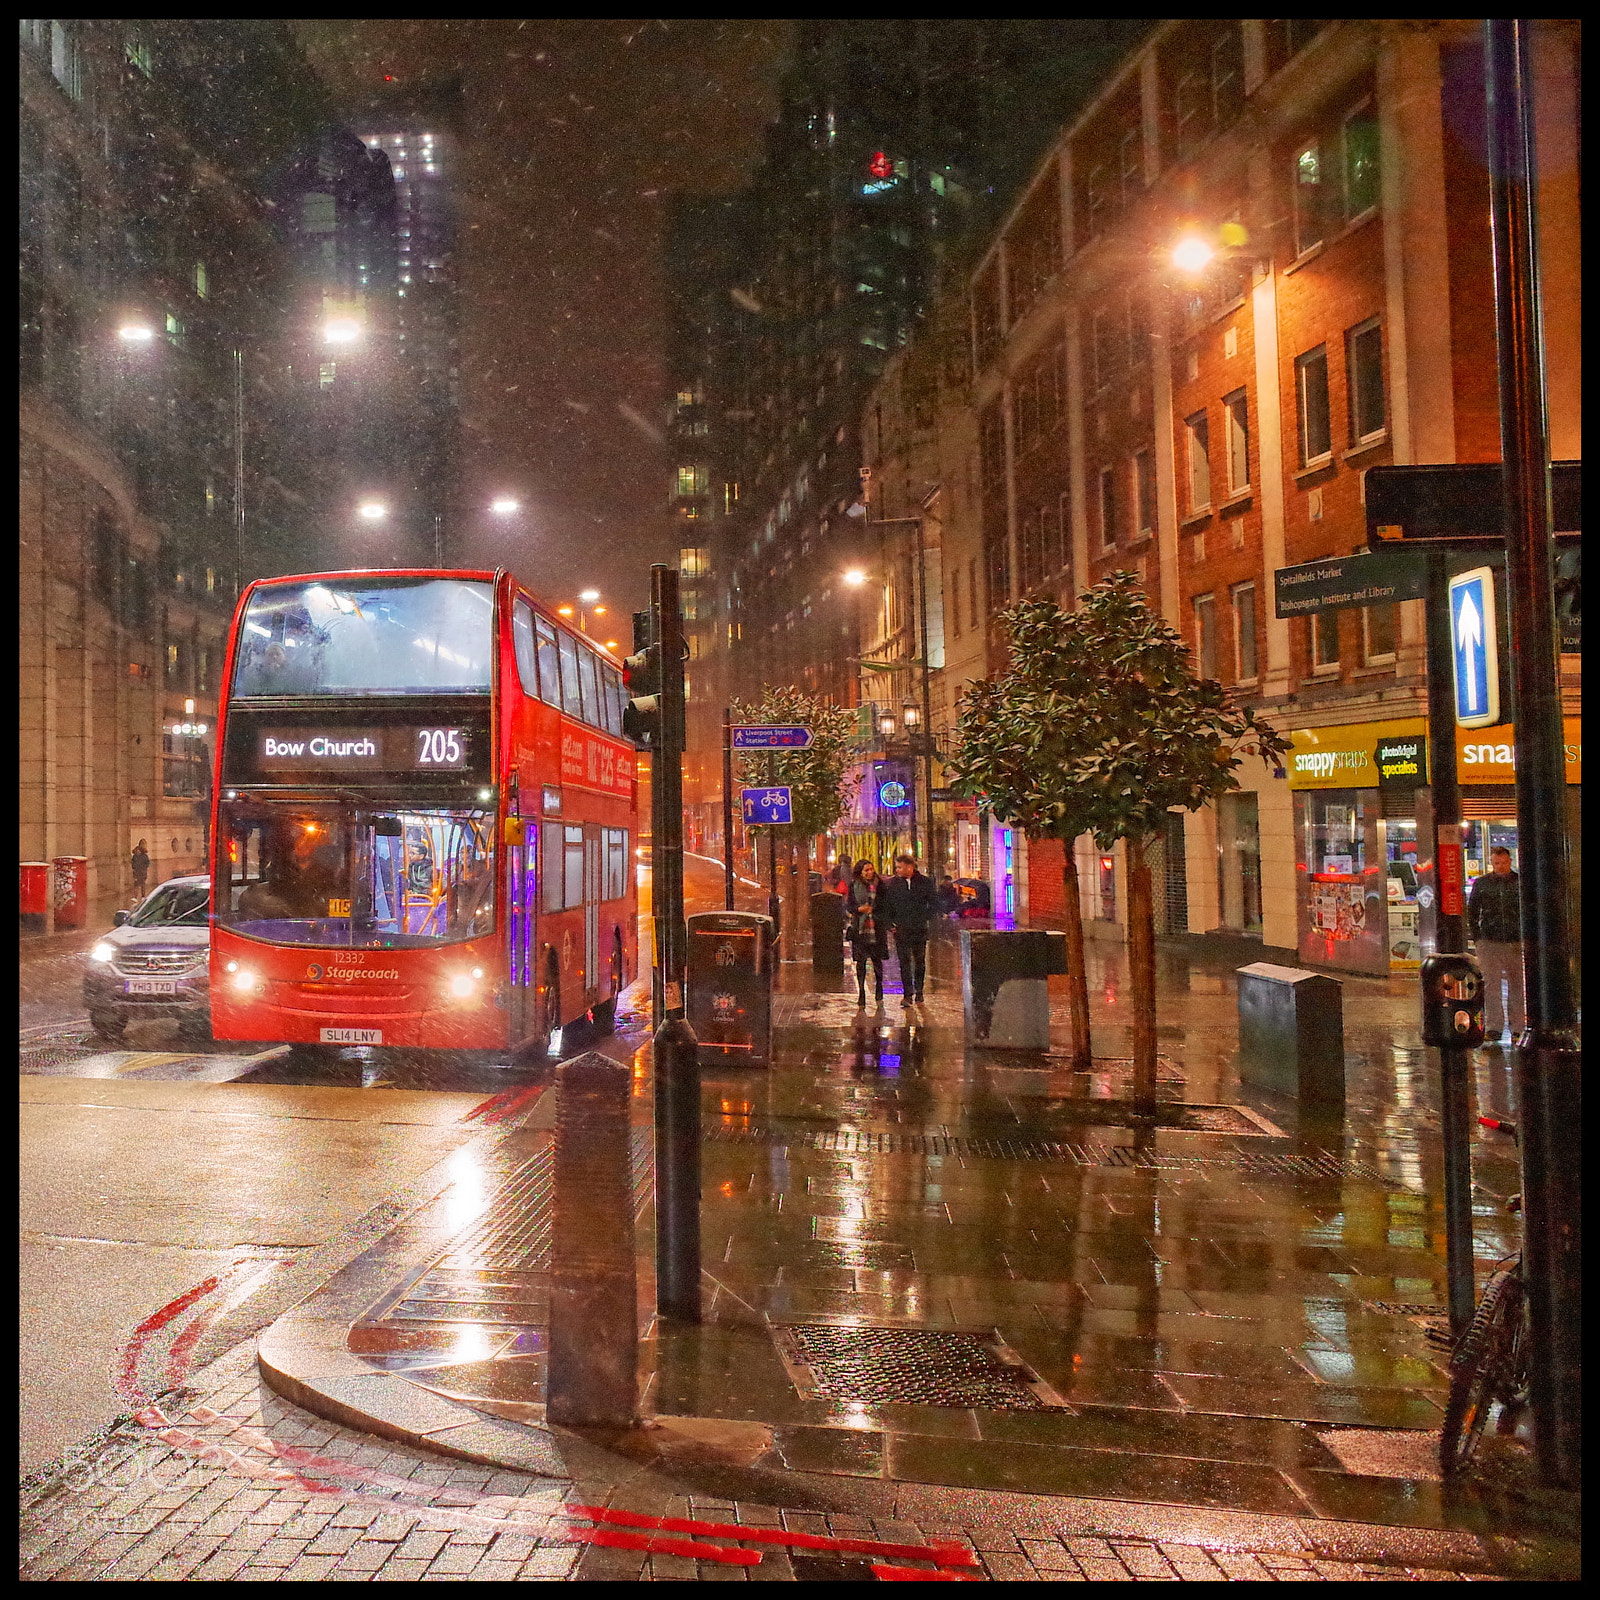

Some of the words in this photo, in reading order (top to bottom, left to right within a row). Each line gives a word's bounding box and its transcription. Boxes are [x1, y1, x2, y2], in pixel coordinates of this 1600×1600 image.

[1280, 573, 1316, 586] Spitalfields
[1317, 568, 1342, 580] Market
[1280, 598, 1319, 610] Bishopsgate
[1322, 592, 1350, 604] Institute
[1352, 589, 1366, 599] and
[1368, 586, 1395, 598] Library
[265, 738, 305, 756] Bow
[309, 737, 375, 756] Church
[418, 729, 460, 763] 205
[1295, 750, 1368, 777] snappysnaps
[1382, 761, 1418, 779] specialists
[1445, 850, 1457, 883] butts
[334, 901, 351, 913] 115
[335, 953, 365, 964] 12332
[326, 966, 399, 982] Stagecoach
[132, 982, 152, 992] YH13
[326, 1029, 351, 1042] SL14
[353, 1030, 376, 1043] LNY
